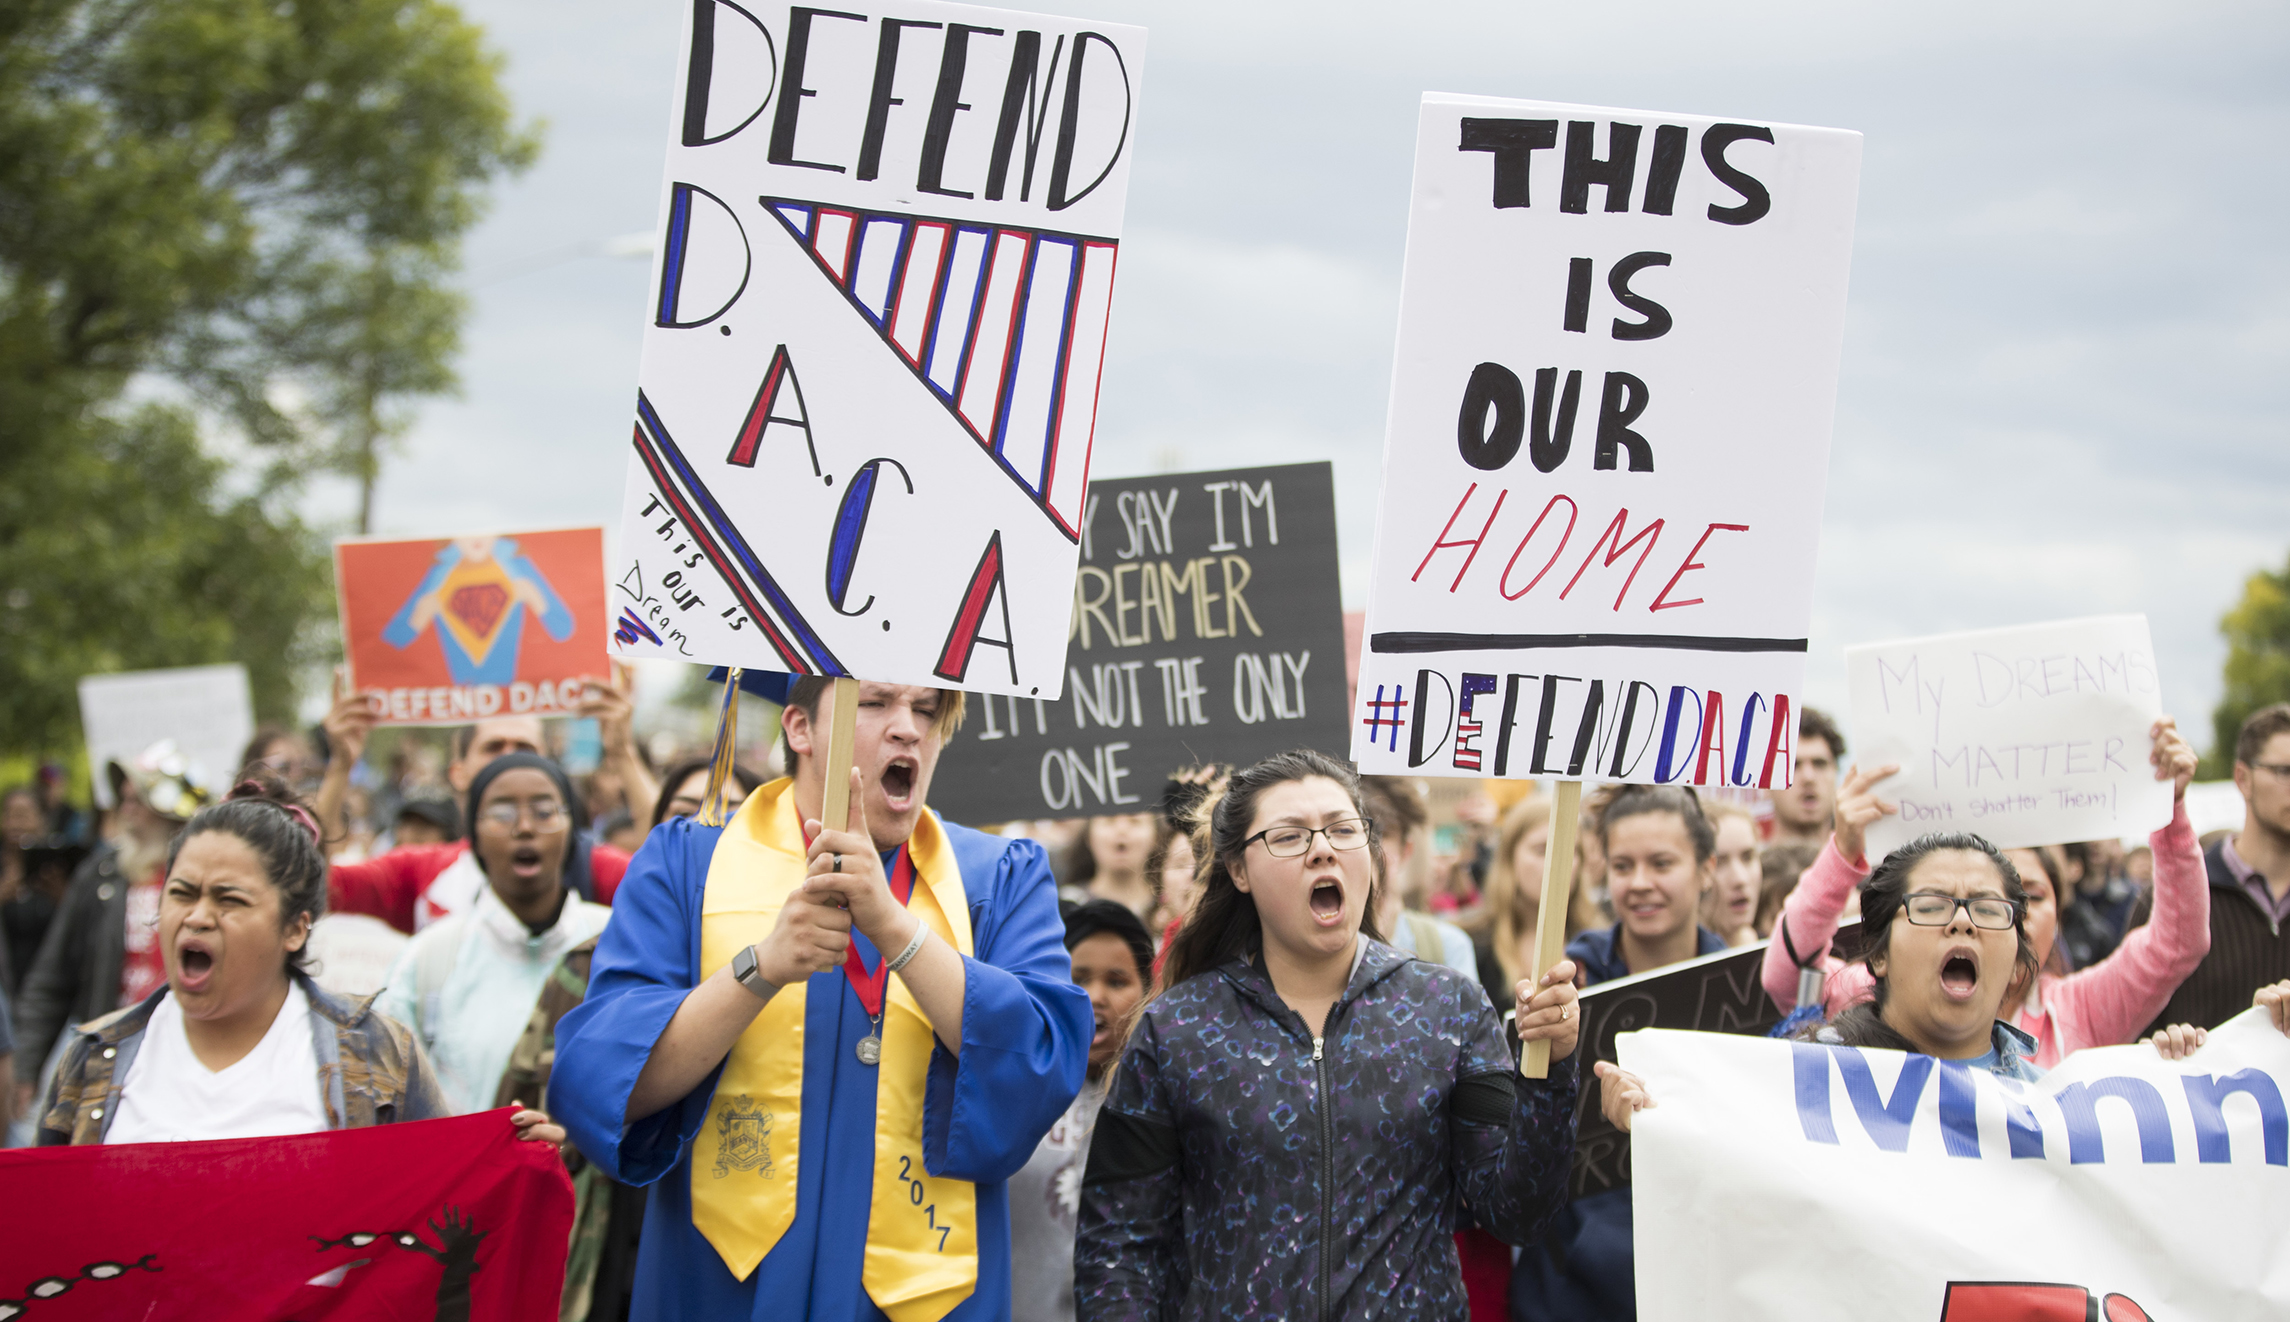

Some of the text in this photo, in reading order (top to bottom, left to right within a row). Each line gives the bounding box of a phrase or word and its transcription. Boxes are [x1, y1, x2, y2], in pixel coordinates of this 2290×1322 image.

[682, 0, 1130, 211] DEFEND
[1458, 117, 1775, 225] THIS
[1563, 251, 1672, 340] IS
[1457, 362, 1654, 473] OUR
[641, 493, 748, 631] This is
[1116, 488, 1179, 560] SAY
[1203, 479, 1279, 552] I'M
[1411, 482, 1750, 613] HOME
[615, 559, 694, 657] Dream
[1068, 554, 1263, 650] REAMER
[366, 683, 501, 719] DEFEND
[1069, 650, 1310, 729] NOT THE ONLY
[1878, 651, 2157, 744] My DREAMS
[1040, 742, 1141, 810] ONE
[1900, 799, 1953, 822] Don't
[2050, 783, 2117, 820] Them!
[1932, 737, 2128, 790] MATTER
[898, 1155, 951, 1252] 2017
